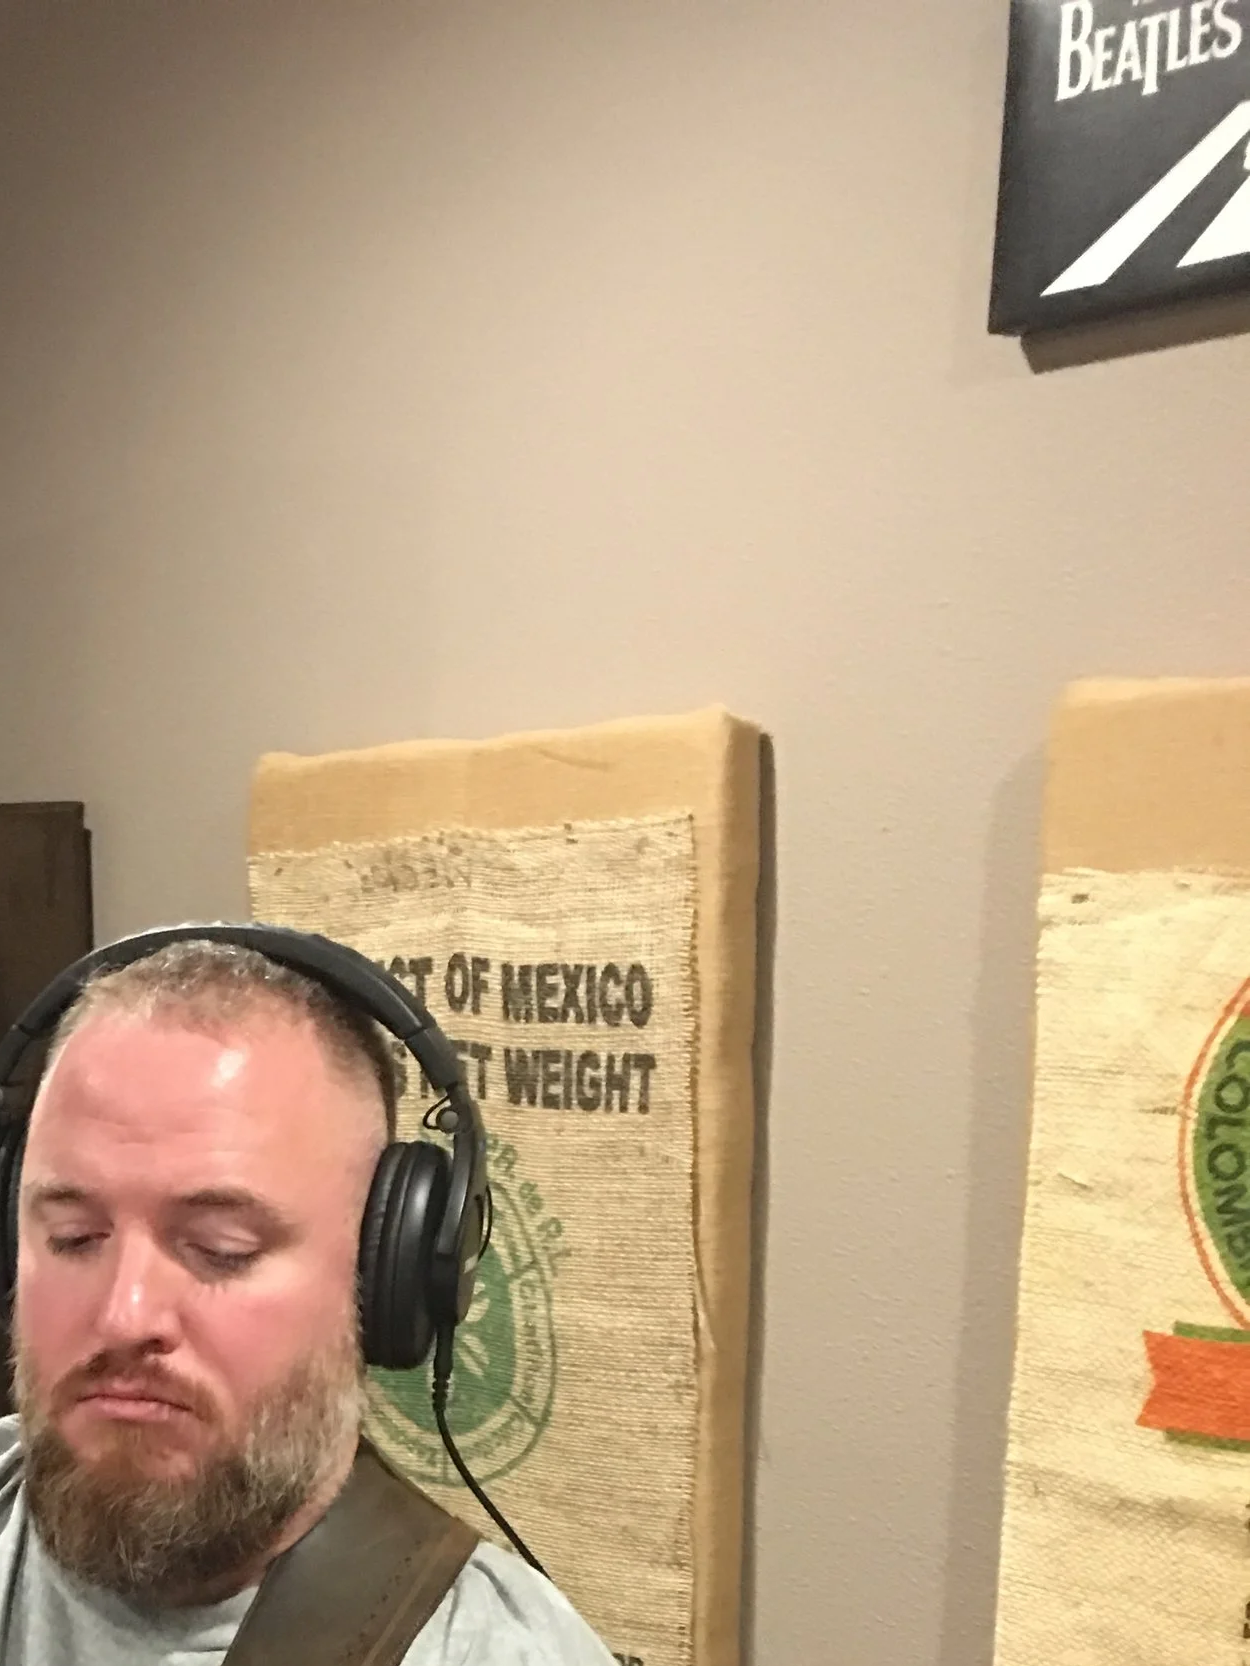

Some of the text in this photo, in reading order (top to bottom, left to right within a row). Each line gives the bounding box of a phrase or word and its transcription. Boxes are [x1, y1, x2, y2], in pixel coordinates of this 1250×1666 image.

[1054, 0, 1242, 102] BEATLES
[445, 952, 491, 1015] OF
[502, 963, 653, 1028] MEXICO
[504, 1048, 657, 1115] WEIGHT
[1206, 1040, 1250, 1290] COLOMB
